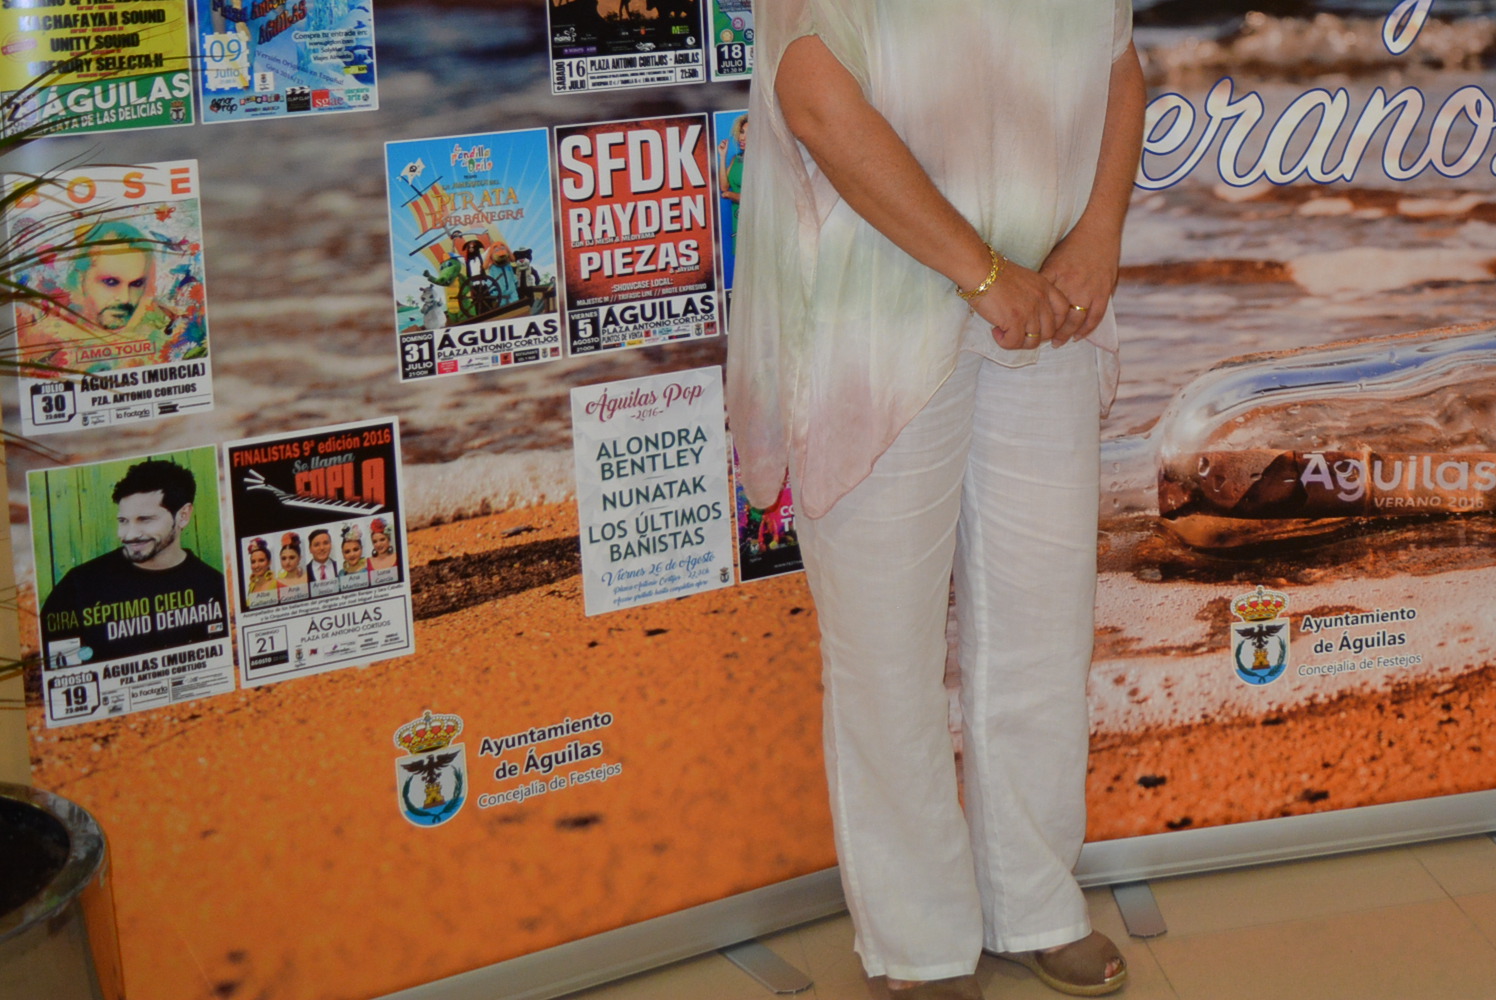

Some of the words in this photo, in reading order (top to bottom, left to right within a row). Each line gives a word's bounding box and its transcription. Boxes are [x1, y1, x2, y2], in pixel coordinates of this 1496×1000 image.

[209, 39, 242, 62] 09
[721, 46, 742, 59] 18
[721, 60, 742, 68] JULIO
[566, 61, 586, 79] 16
[42, 70, 190, 119] ÁGUILAS
[568, 80, 586, 90] JULIO
[560, 124, 707, 201] SFDK
[435, 187, 519, 211] PIRATA
[568, 194, 705, 243] RAYDEN
[580, 239, 700, 280] PIEZAS
[570, 311, 598, 320] VIERNES
[602, 295, 715, 328] ÁGUILAS
[401, 333, 432, 344] DOMINGO
[437, 318, 558, 350] ÁGUILAS
[572, 337, 599, 346] AGOSTO
[577, 319, 592, 339] 5
[80, 348, 113, 360] AMO
[117, 342, 152, 356] TOUR
[404, 342, 431, 363] 31
[80, 370, 139, 392] ÁGUILAS
[142, 363, 205, 385] (MURCIA)
[405, 361, 433, 372] JULIO
[42, 396, 66, 414] 30
[585, 388, 658, 422] Águilas
[663, 383, 705, 406] Pop
[234, 442, 300, 467] FINALISTAS
[303, 440, 316, 456] 9ª
[317, 436, 360, 453] edición
[363, 429, 391, 445] 2016
[596, 425, 707, 461] ALONDRA
[601, 446, 704, 481] BENTLEY
[295, 457, 385, 506] COPLA
[602, 475, 706, 511] NUNATAK
[1374, 497, 1441, 507] VERANO
[1447, 496, 1483, 508] 2016
[589, 520, 627, 544] LOS
[636, 502, 722, 534] ÚLTIMOS
[610, 527, 705, 562] BAÑISTAS
[602, 569, 646, 587] Viernes
[648, 563, 662, 576] 26
[665, 558, 677, 571] de
[679, 552, 715, 571] Agosto
[83, 595, 150, 627] SÉPTIMO
[154, 588, 194, 612] CIELO
[108, 616, 151, 641] DAVID
[156, 601, 222, 631] DEMARÍA
[307, 606, 383, 634] ÁGUILAS
[1302, 607, 1416, 633] Ayuntamiento
[256, 635, 276, 653] 21
[1313, 640, 1333, 654] de
[1338, 631, 1406, 654] Águilas
[102, 655, 158, 679] ÁGUILAS
[162, 644, 223, 668] (MURCIA)
[1359, 658, 1374, 669] de
[1377, 653, 1422, 667] Festejos
[54, 673, 93, 687] agosto
[61, 686, 88, 708] 19
[480, 712, 612, 758] Ayuntamiento
[495, 763, 518, 780] de
[524, 740, 602, 774] Águilas
[549, 775, 566, 790] de
[570, 764, 621, 785] Festejos
